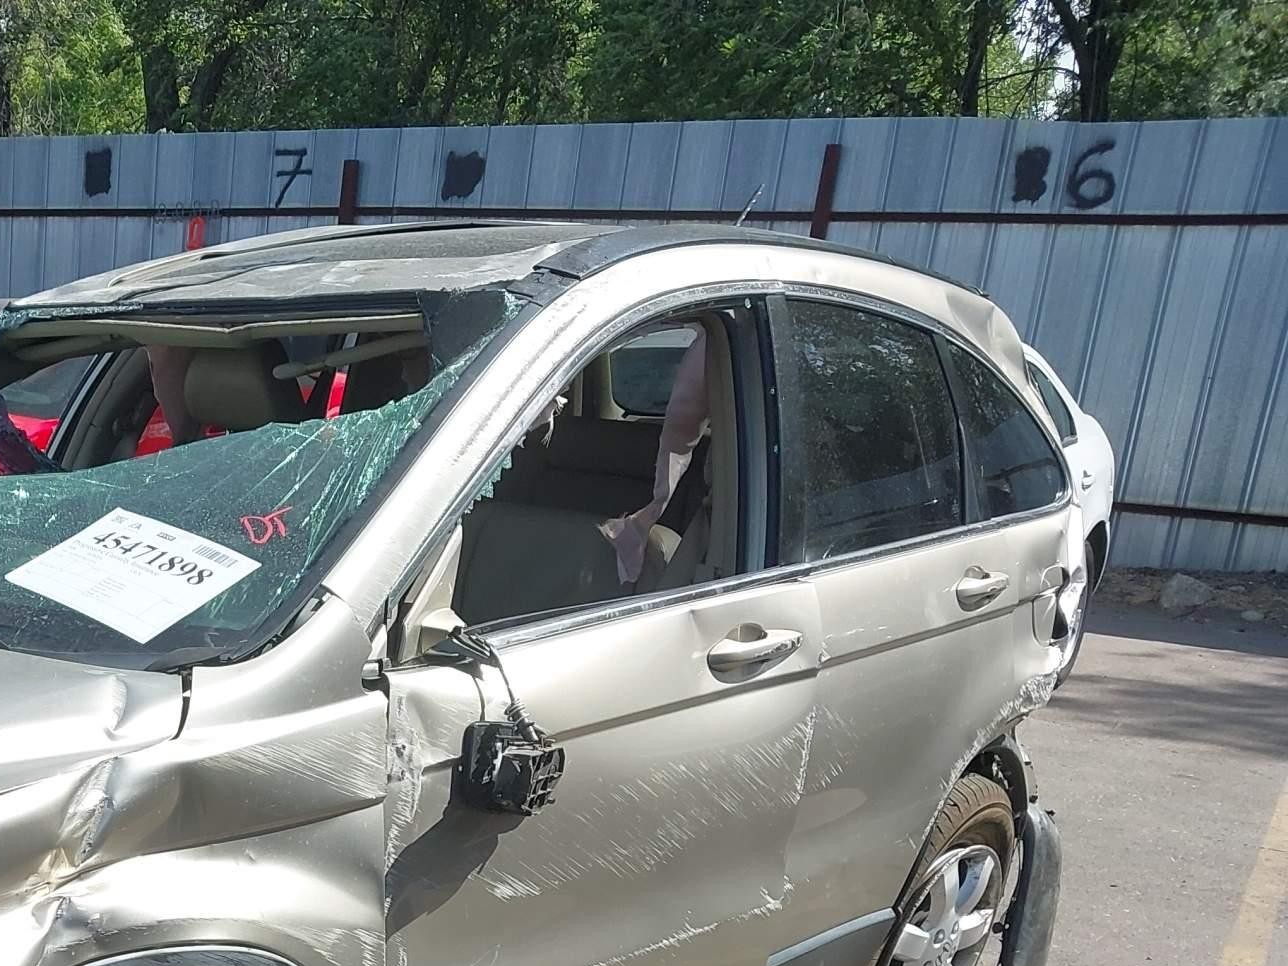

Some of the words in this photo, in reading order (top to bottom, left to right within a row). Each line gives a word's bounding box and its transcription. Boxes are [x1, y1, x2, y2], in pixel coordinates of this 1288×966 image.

[274, 148, 313, 208] 7
[1065, 139, 1117, 210] 6
[92, 531, 214, 586] 45471898
